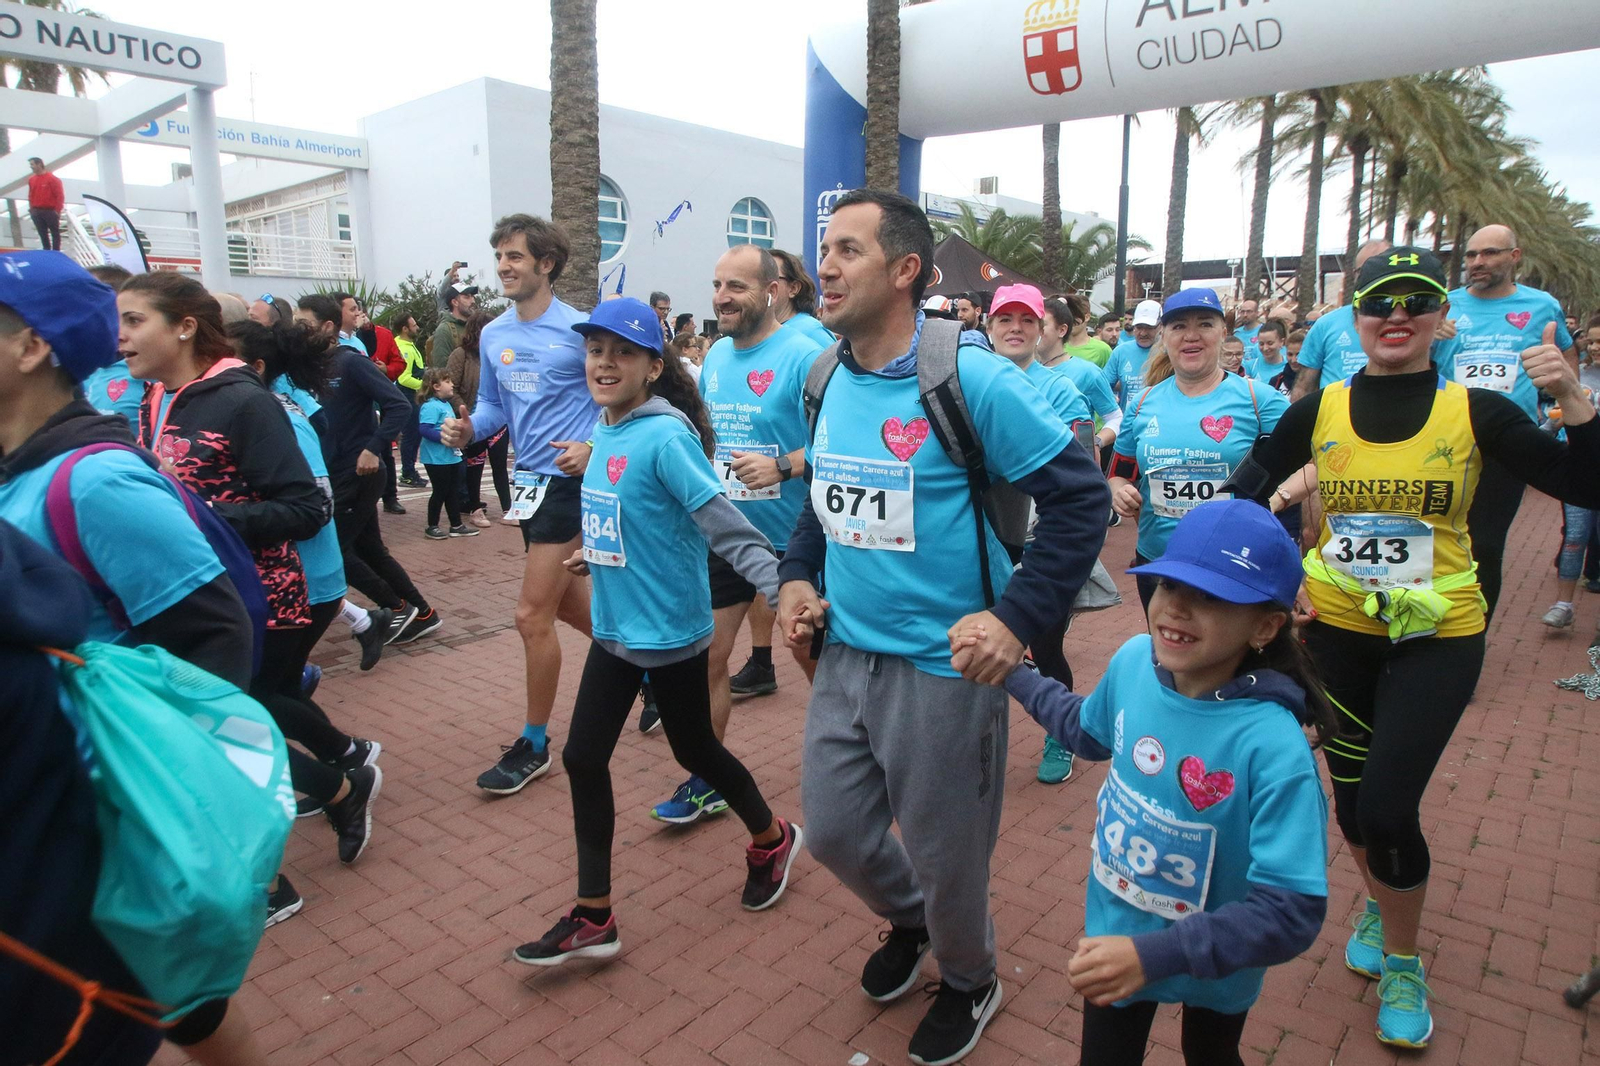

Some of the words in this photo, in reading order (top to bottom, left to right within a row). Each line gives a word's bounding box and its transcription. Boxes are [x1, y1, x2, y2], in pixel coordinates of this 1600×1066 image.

[36, 19, 202, 70] NAUTICO
[1136, 17, 1282, 71] CIUDAD
[251, 131, 291, 148] Bahía
[294, 138, 362, 158] Almeriport
[511, 371, 540, 383] SILVESTRE
[1465, 364, 1507, 379] 263
[711, 401, 735, 411] Runner
[736, 402, 762, 414] Fashion
[710, 412, 737, 420] Carrera
[738, 413, 751, 423] azul
[730, 421, 754, 431] autismo
[1147, 456, 1183, 465] Carrera
[1149, 445, 1182, 456] Runner
[1184, 447, 1221, 460] Fashion
[821, 459, 840, 469] Runner
[839, 461, 860, 472] Fashion
[862, 465, 889, 475] Carrera
[889, 468, 904, 477] azul
[827, 471, 834, 481] el
[835, 472, 861, 484] autismo
[1163, 481, 1215, 501] 540
[1319, 479, 1424, 496] RUNNERS
[826, 483, 886, 520] 671
[1166, 500, 1194, 509] MARGARITA
[1428, 482, 1448, 512] TEAM
[845, 516, 867, 531] JAVIER
[1335, 537, 1410, 565] 343
[1351, 565, 1389, 577] ASUNCION
[1142, 812, 1180, 837] Carrera
[1181, 831, 1202, 842] azul
[1108, 854, 1137, 883] LYNDA
[1151, 896, 1193, 914] fashiOn
